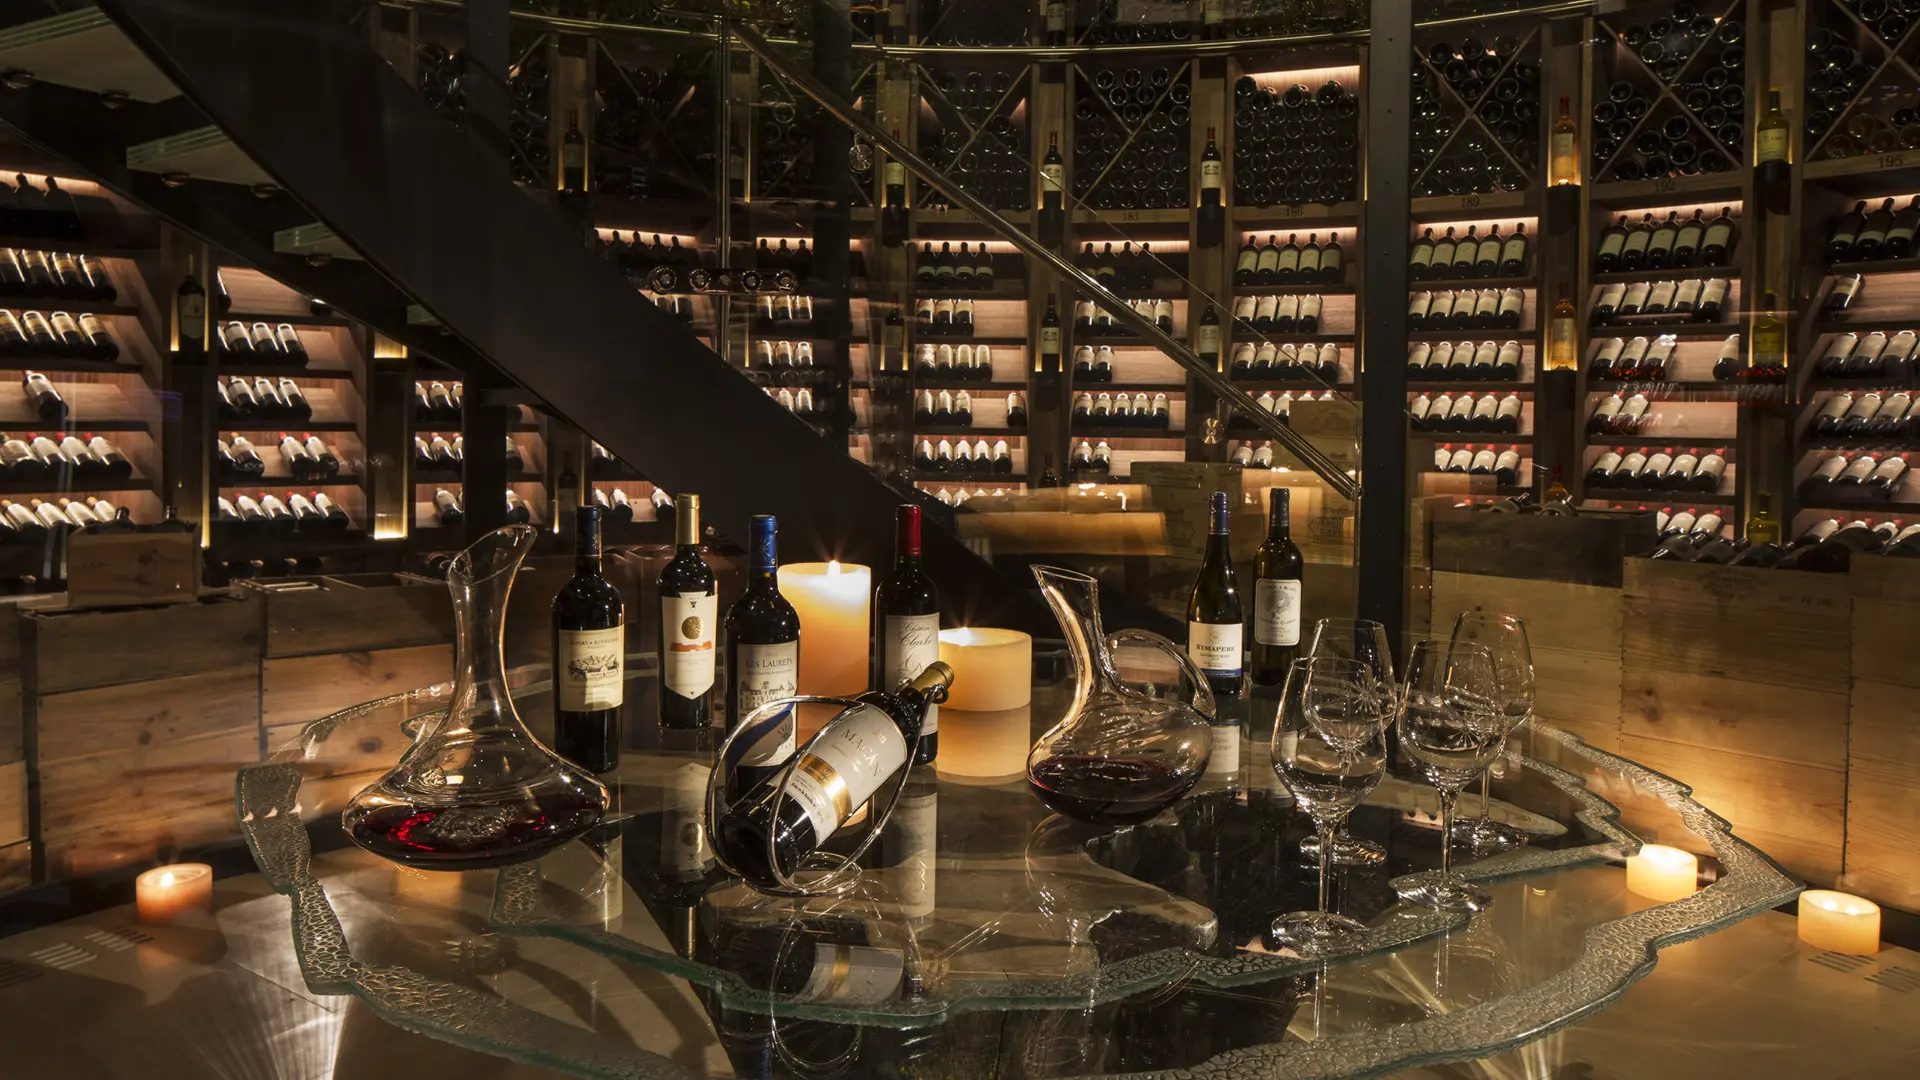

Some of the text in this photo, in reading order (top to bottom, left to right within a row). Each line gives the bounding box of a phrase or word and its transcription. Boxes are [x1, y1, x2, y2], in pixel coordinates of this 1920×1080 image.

[1878, 155, 1903, 168] 195
[1655, 179, 1676, 192] 192
[1461, 196, 1480, 208] 189
[1122, 211, 1140, 222] 183
[1284, 207, 1304, 218] 186
[746, 659, 760, 668] LES
